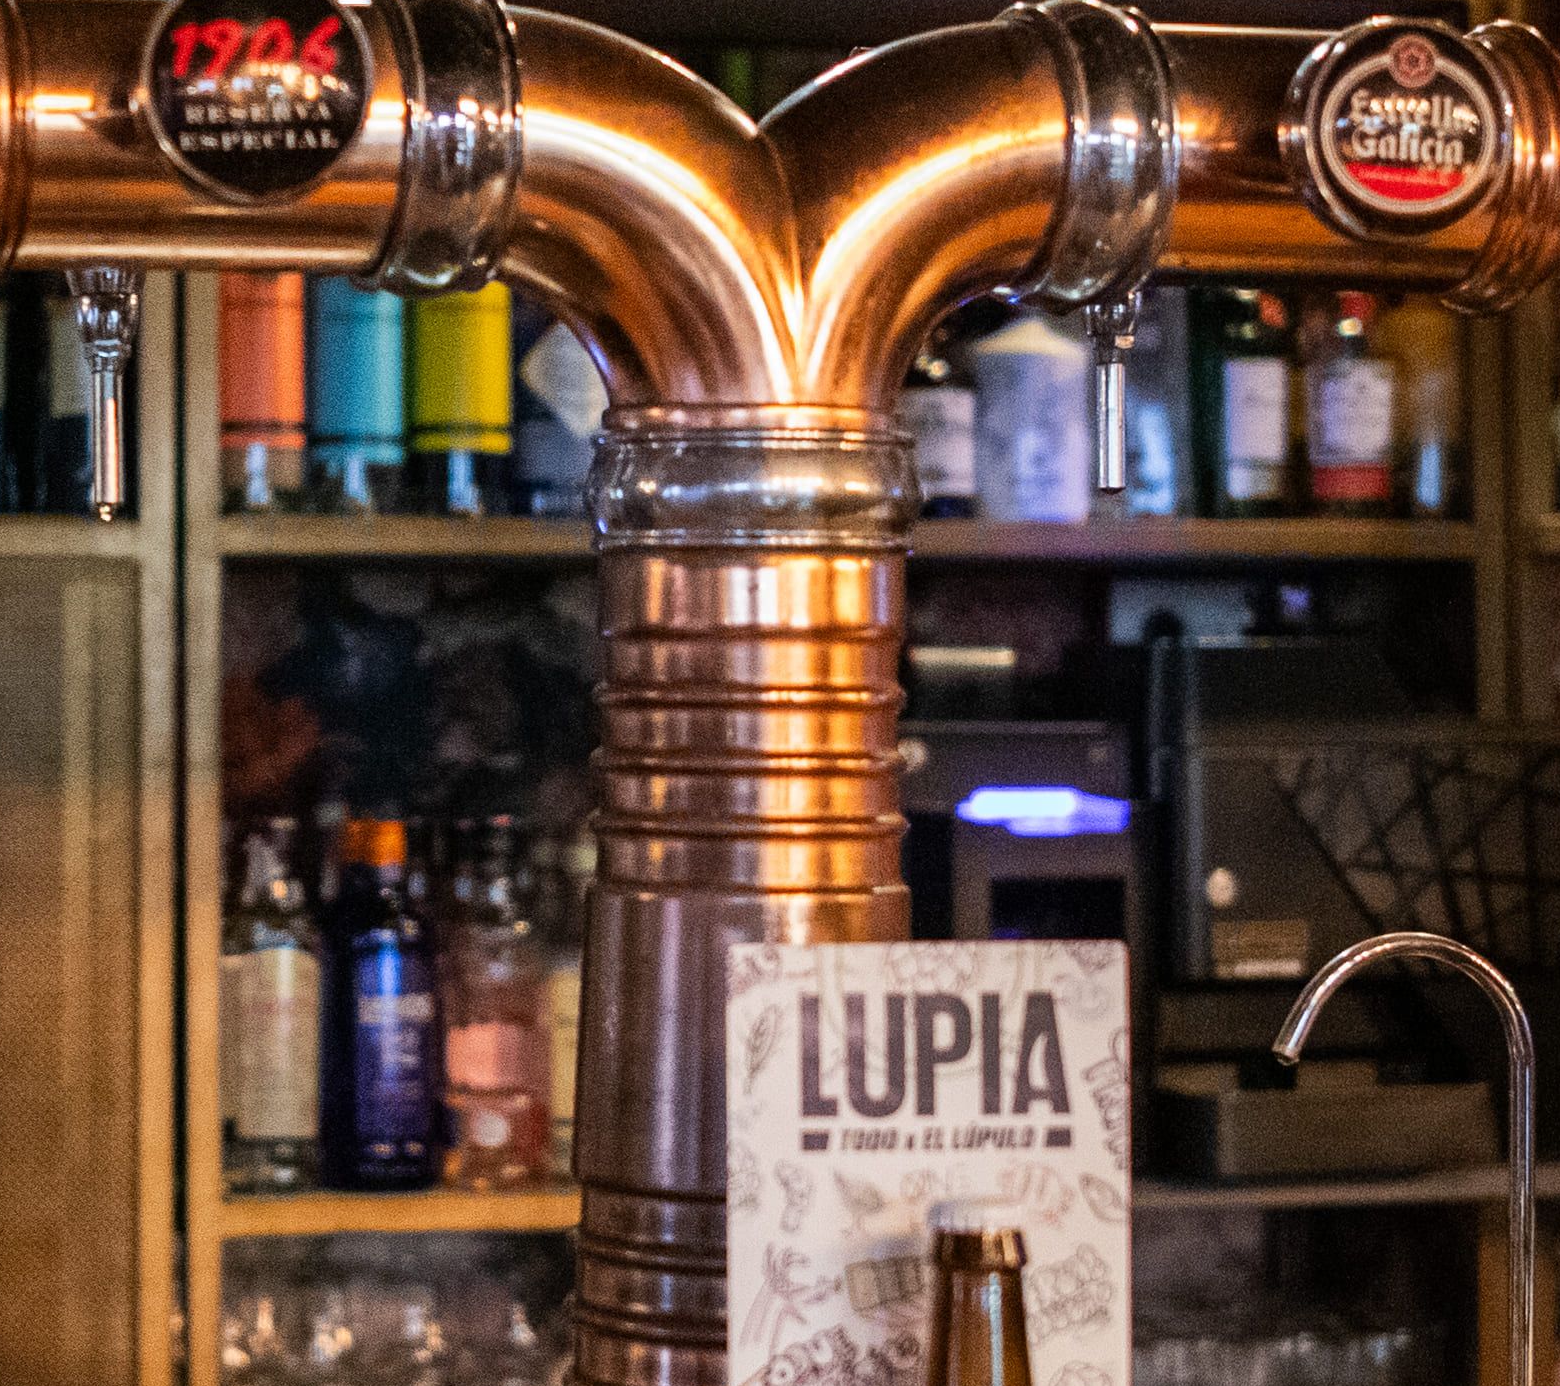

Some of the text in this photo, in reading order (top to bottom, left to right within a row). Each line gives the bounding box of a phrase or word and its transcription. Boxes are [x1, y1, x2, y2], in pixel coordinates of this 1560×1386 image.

[171, 16, 341, 79] 1906
[800, 991, 1072, 1117] LUPIA
[922, 1126, 945, 1151] EL
